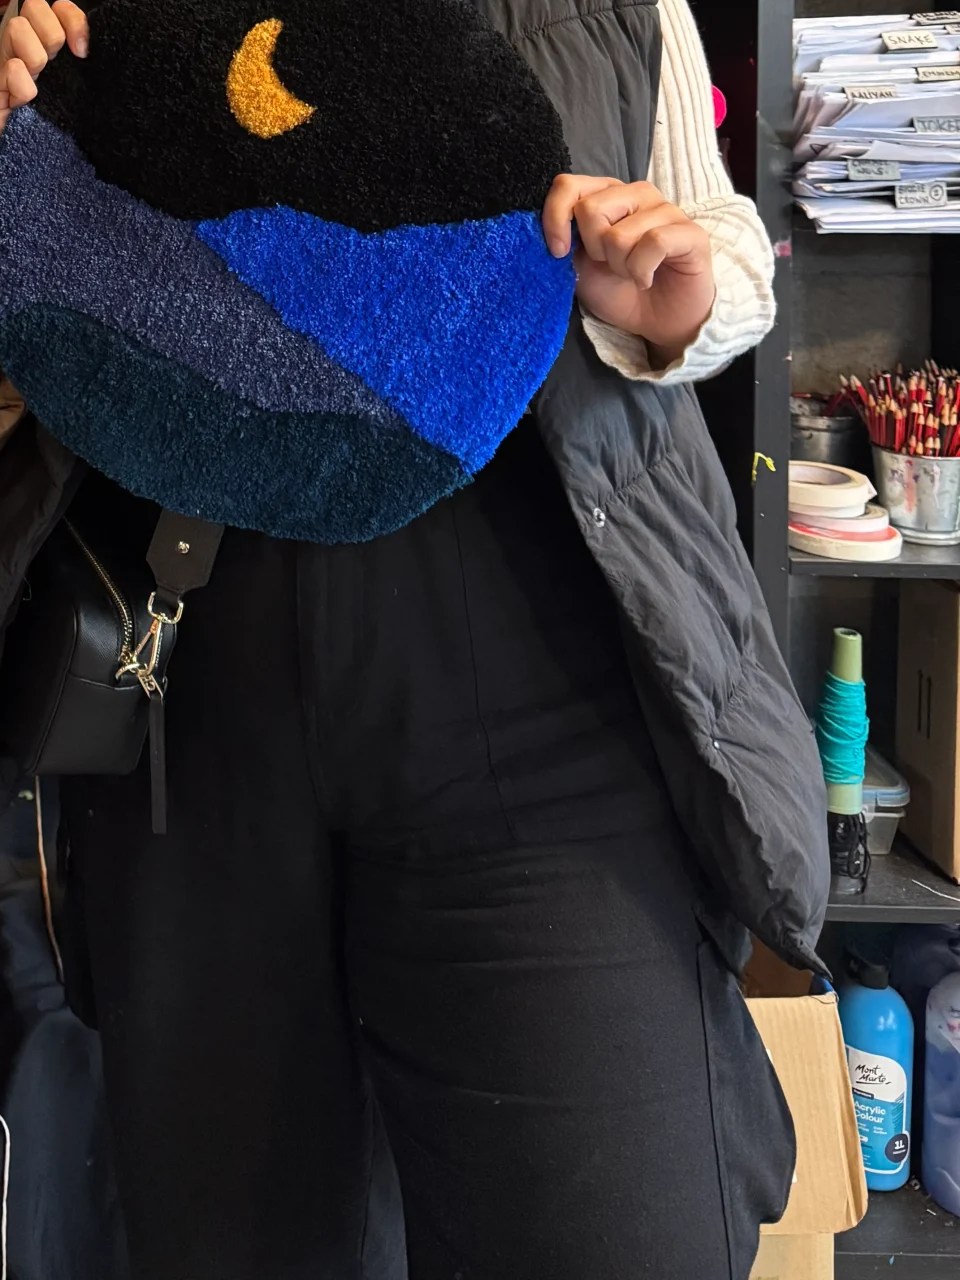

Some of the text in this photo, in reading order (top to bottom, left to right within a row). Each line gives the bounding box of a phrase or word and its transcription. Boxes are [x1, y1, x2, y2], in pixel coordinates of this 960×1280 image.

[889, 33, 933, 46] SNAKE
[855, 1064, 881, 1075] Mont
[854, 1100, 886, 1116] Acrylic
[894, 1140, 905, 1150] 1L
